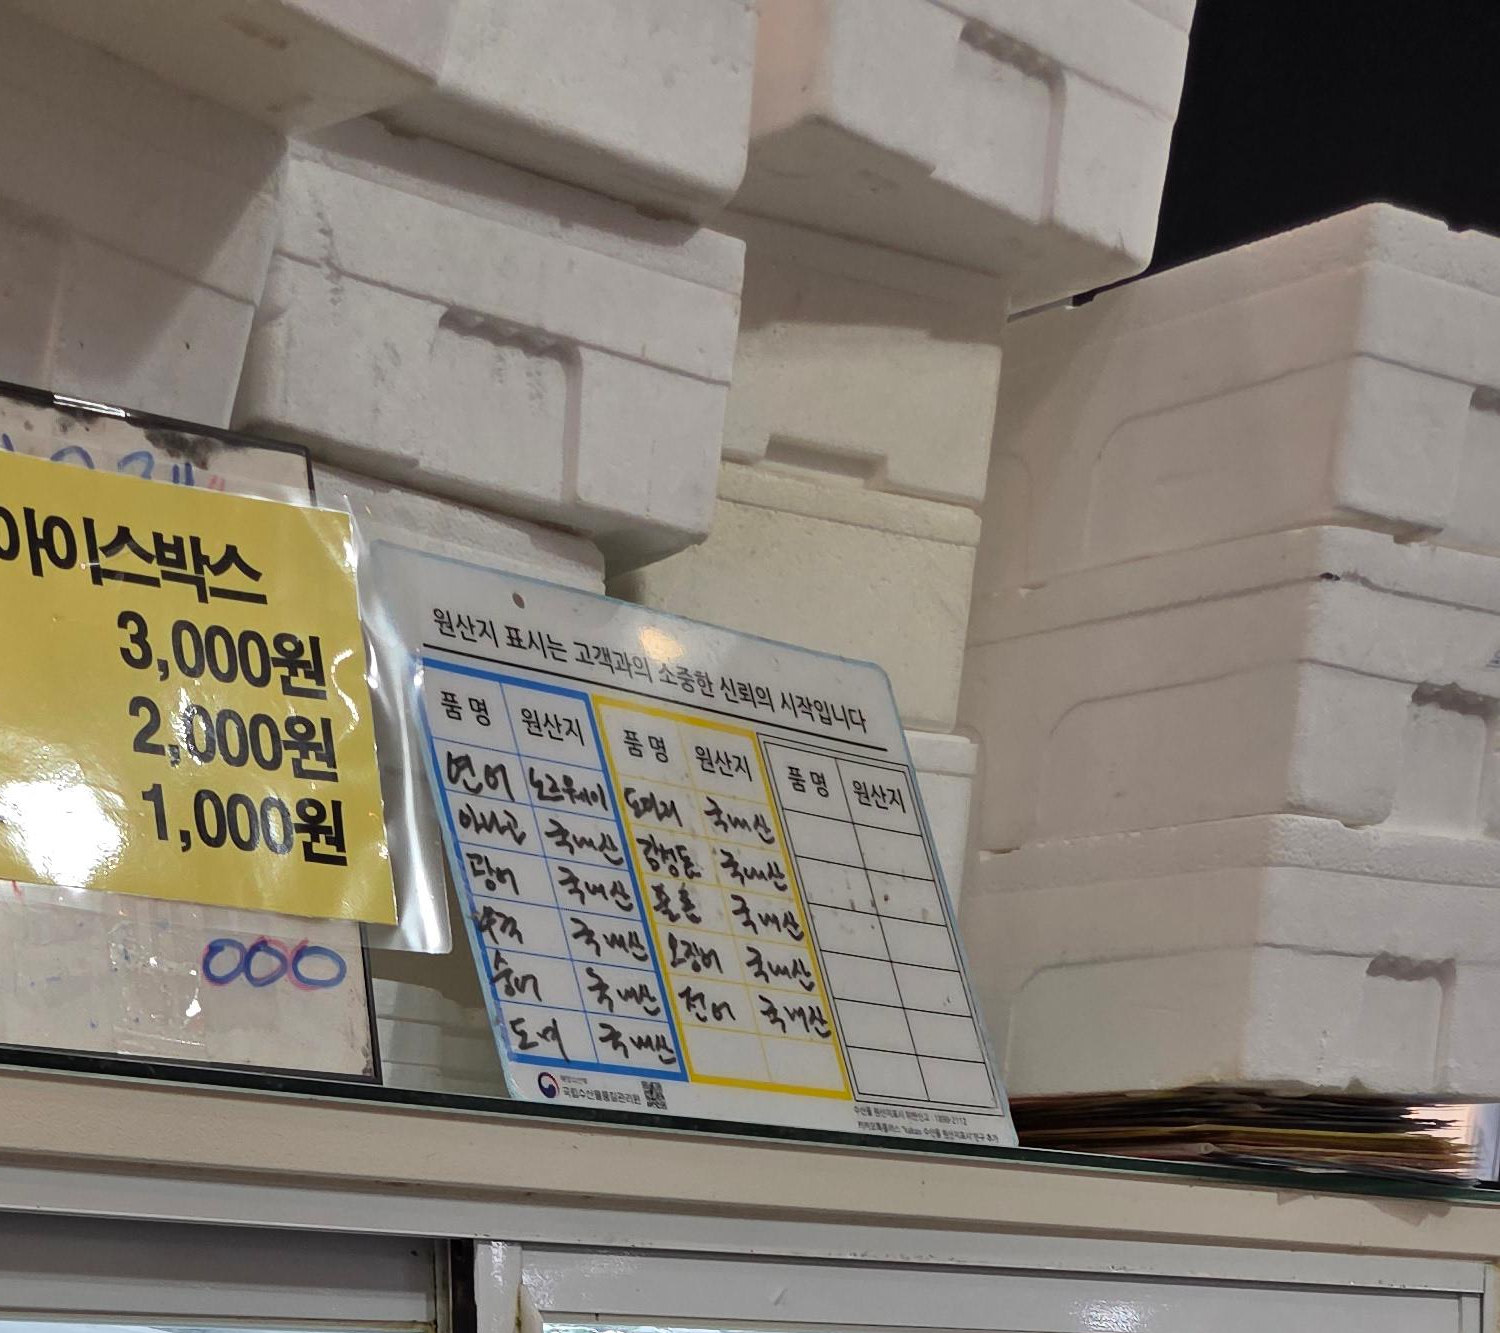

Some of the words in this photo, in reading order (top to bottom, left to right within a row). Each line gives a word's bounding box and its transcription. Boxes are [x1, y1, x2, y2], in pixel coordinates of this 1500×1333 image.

[117, 611, 327, 700] 3,000원
[433, 608, 499, 648] 원산지
[504, 625, 567, 663] 표시는
[573, 641, 653, 683] 고객과의
[658, 663, 714, 698] 소중한
[720, 677, 775, 712] 신뢰의
[780, 692, 868, 733] 시작입니다
[129, 697, 338, 784] 2,000원
[521, 708, 584, 746] 원산지
[695, 746, 752, 782] 원산지
[852, 780, 906, 813] 원산지
[141, 785, 348, 866] 1,000원
[545, 818, 624, 865] 국내산
[704, 796, 774, 844] 국내산
[466, 852, 519, 895] 광어
[558, 866, 633, 912] 국내산
[720, 849, 788, 891] 국내산
[747, 946, 815, 992] 국내산
[759, 994, 831, 1038] 국내산
[599, 1022, 676, 1064] 국내산
